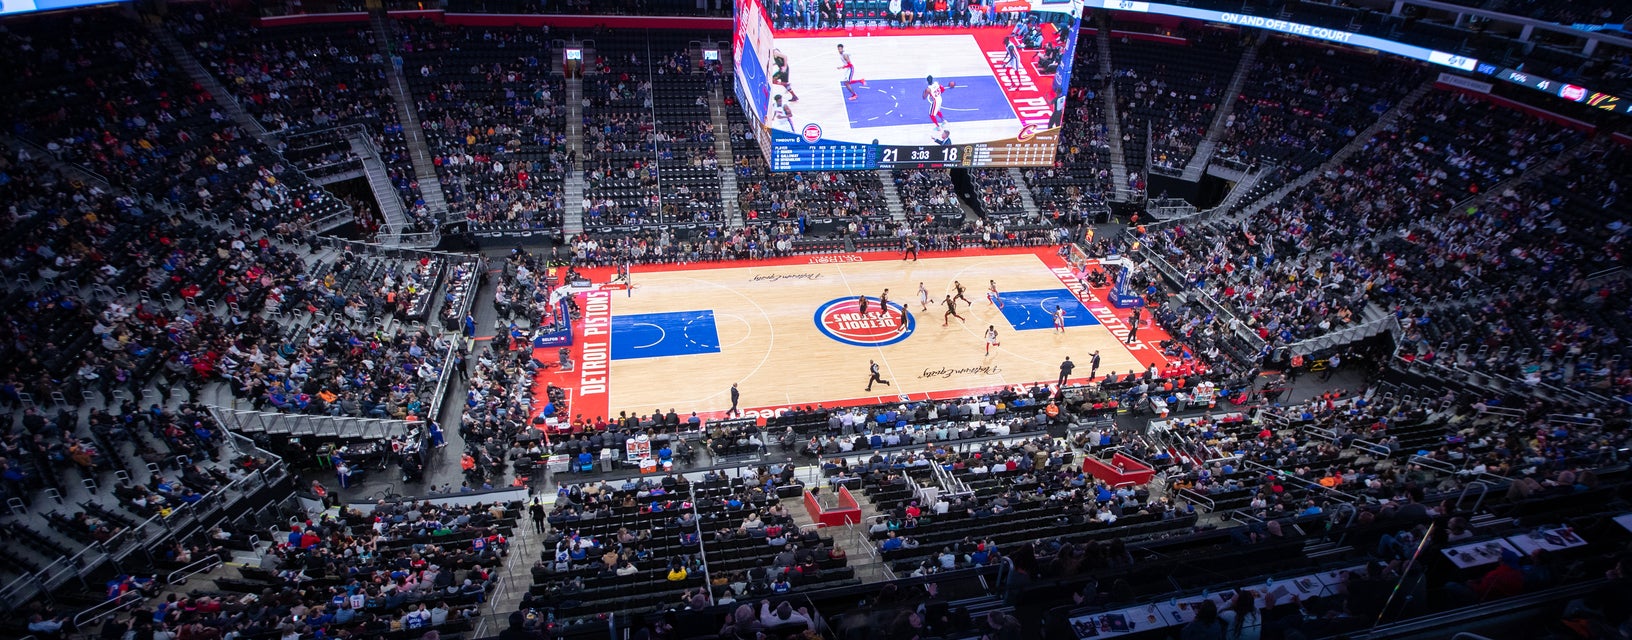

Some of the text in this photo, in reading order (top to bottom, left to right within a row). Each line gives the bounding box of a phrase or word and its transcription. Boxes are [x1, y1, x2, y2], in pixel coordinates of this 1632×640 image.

[1221, 12, 1352, 42] ON AND OFF THE COURT
[882, 148, 898, 162] 21
[911, 150, 930, 160] 3:03
[942, 147, 958, 161] 18
[832, 311, 894, 322] PISTONS
[838, 319, 898, 331] DETROIT
[580, 291, 609, 396] DETROIT PISTONS
